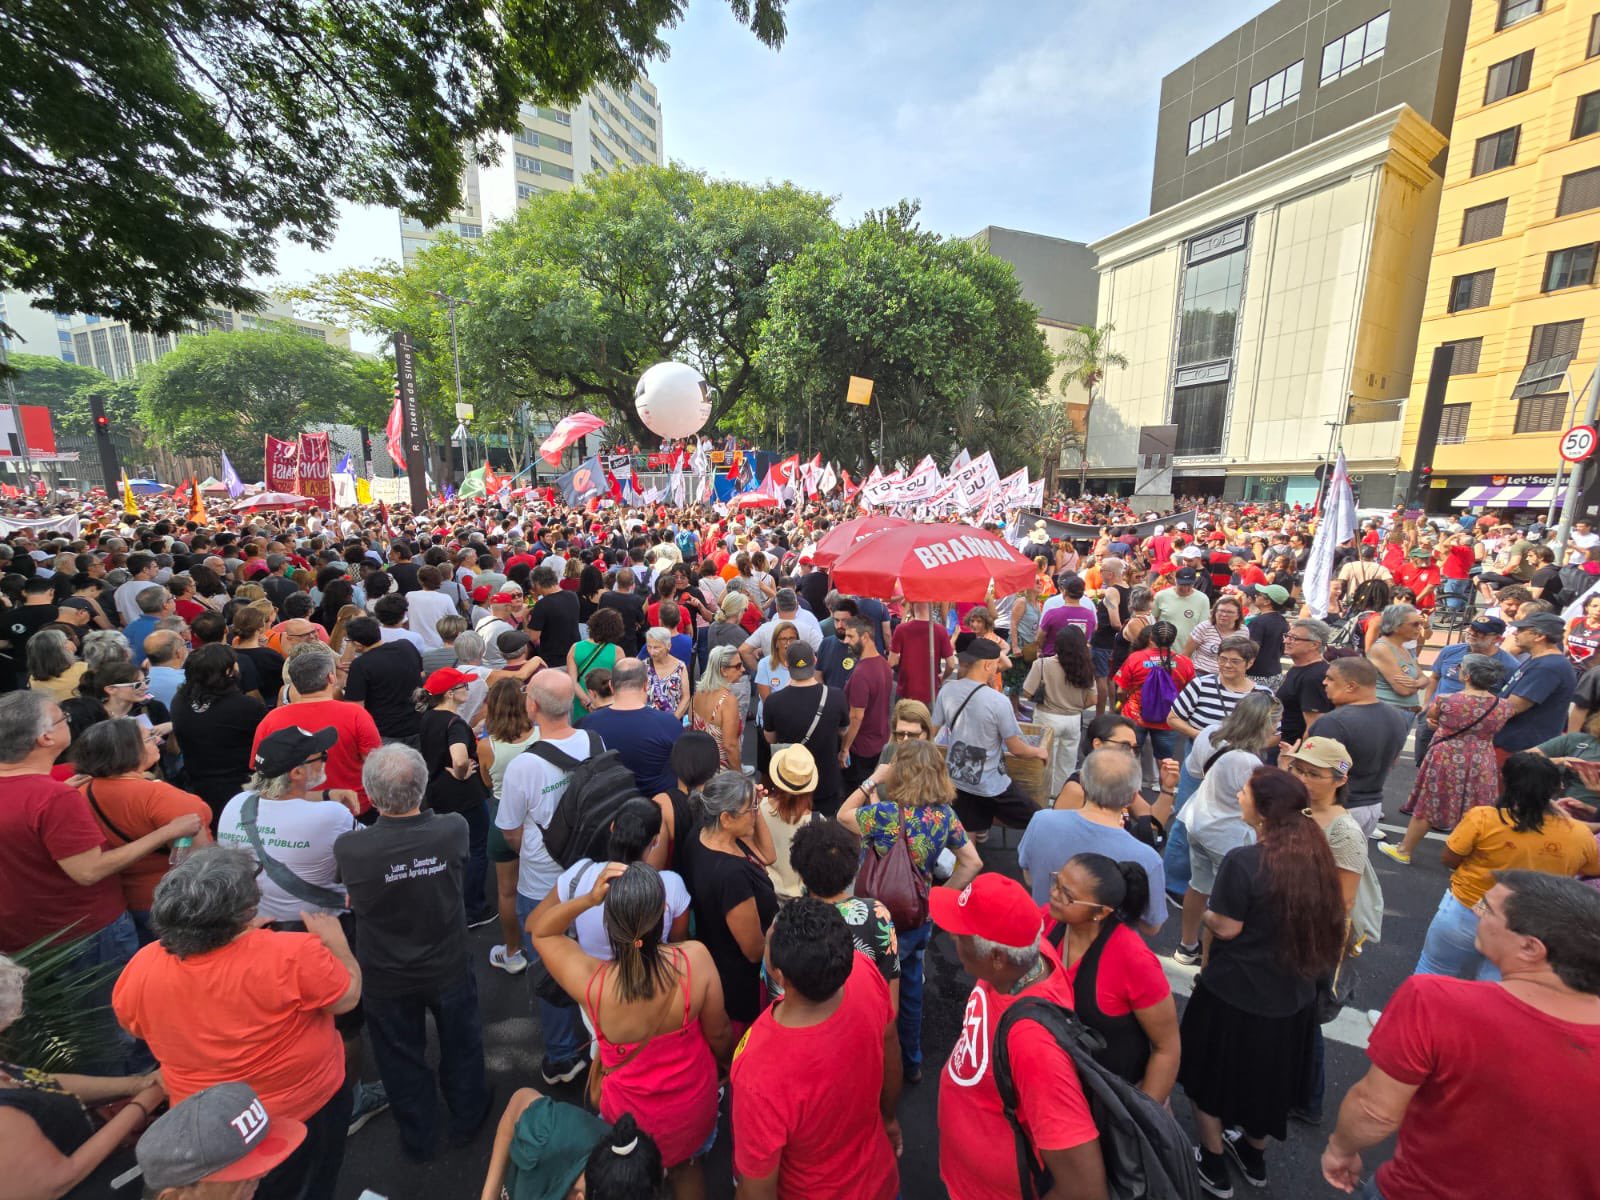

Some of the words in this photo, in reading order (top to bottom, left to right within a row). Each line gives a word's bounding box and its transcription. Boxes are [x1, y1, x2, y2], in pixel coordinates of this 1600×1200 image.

[404, 353, 413, 379] Silva
[407, 382, 414, 395] da
[407, 396, 418, 438] Teixeira
[412, 440, 420, 451] R.
[1566, 433, 1590, 450] 50
[1260, 475, 1284, 483] KIKO
[914, 535, 1016, 570] BRAHMA
[236, 822, 276, 834] PEUISA
[268, 838, 310, 849] PÚBLICA
[231, 1098, 269, 1144] ny
